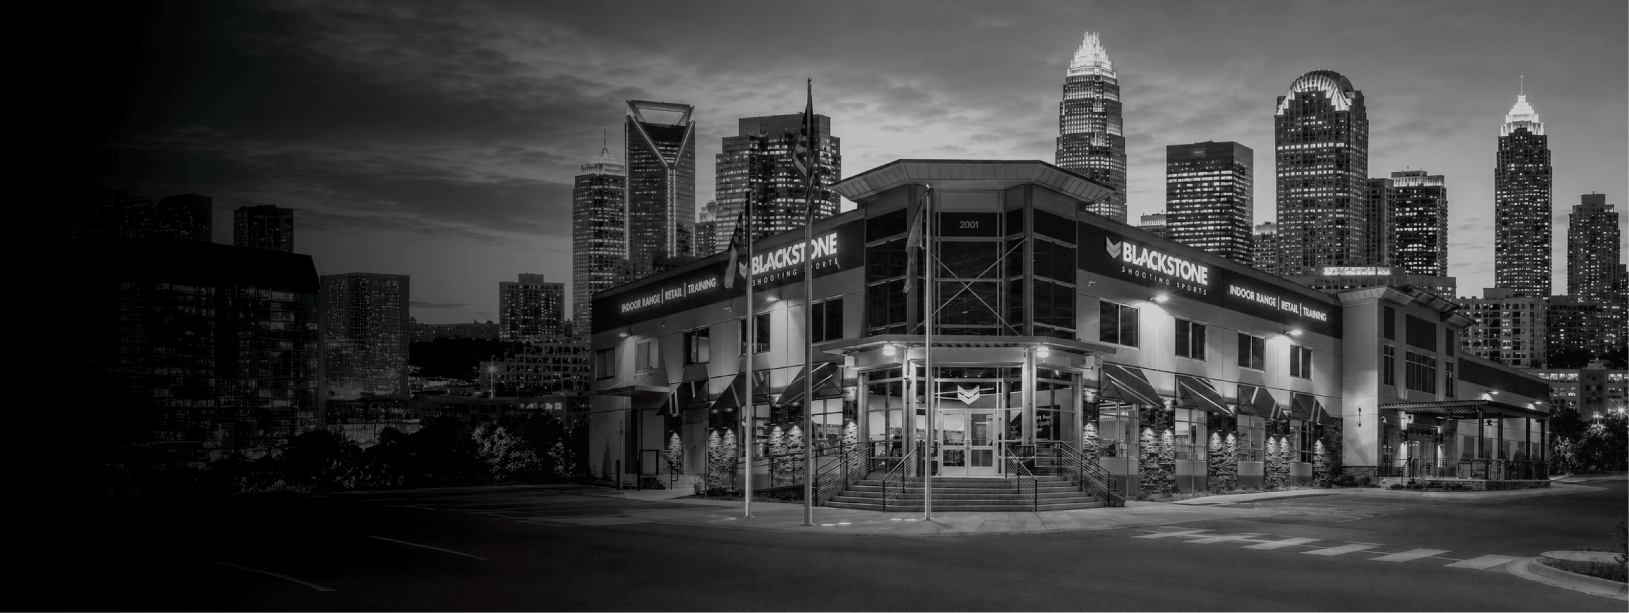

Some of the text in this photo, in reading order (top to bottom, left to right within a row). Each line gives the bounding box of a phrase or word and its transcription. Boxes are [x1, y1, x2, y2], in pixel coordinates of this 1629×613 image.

[960, 221, 979, 229] 2001
[752, 232, 837, 275] BLACKSTONE
[1123, 241, 1208, 285] BLACKSTONE
[752, 258, 838, 287] SHOOTING ORTS
[1122, 266, 1207, 296] SHOOTING SPORTS
[621, 278, 717, 313] INDOOR RANGE RETAIL TRAINING
[1229, 284, 1327, 322] INDOOR RANGE RETAIL TRAINING
